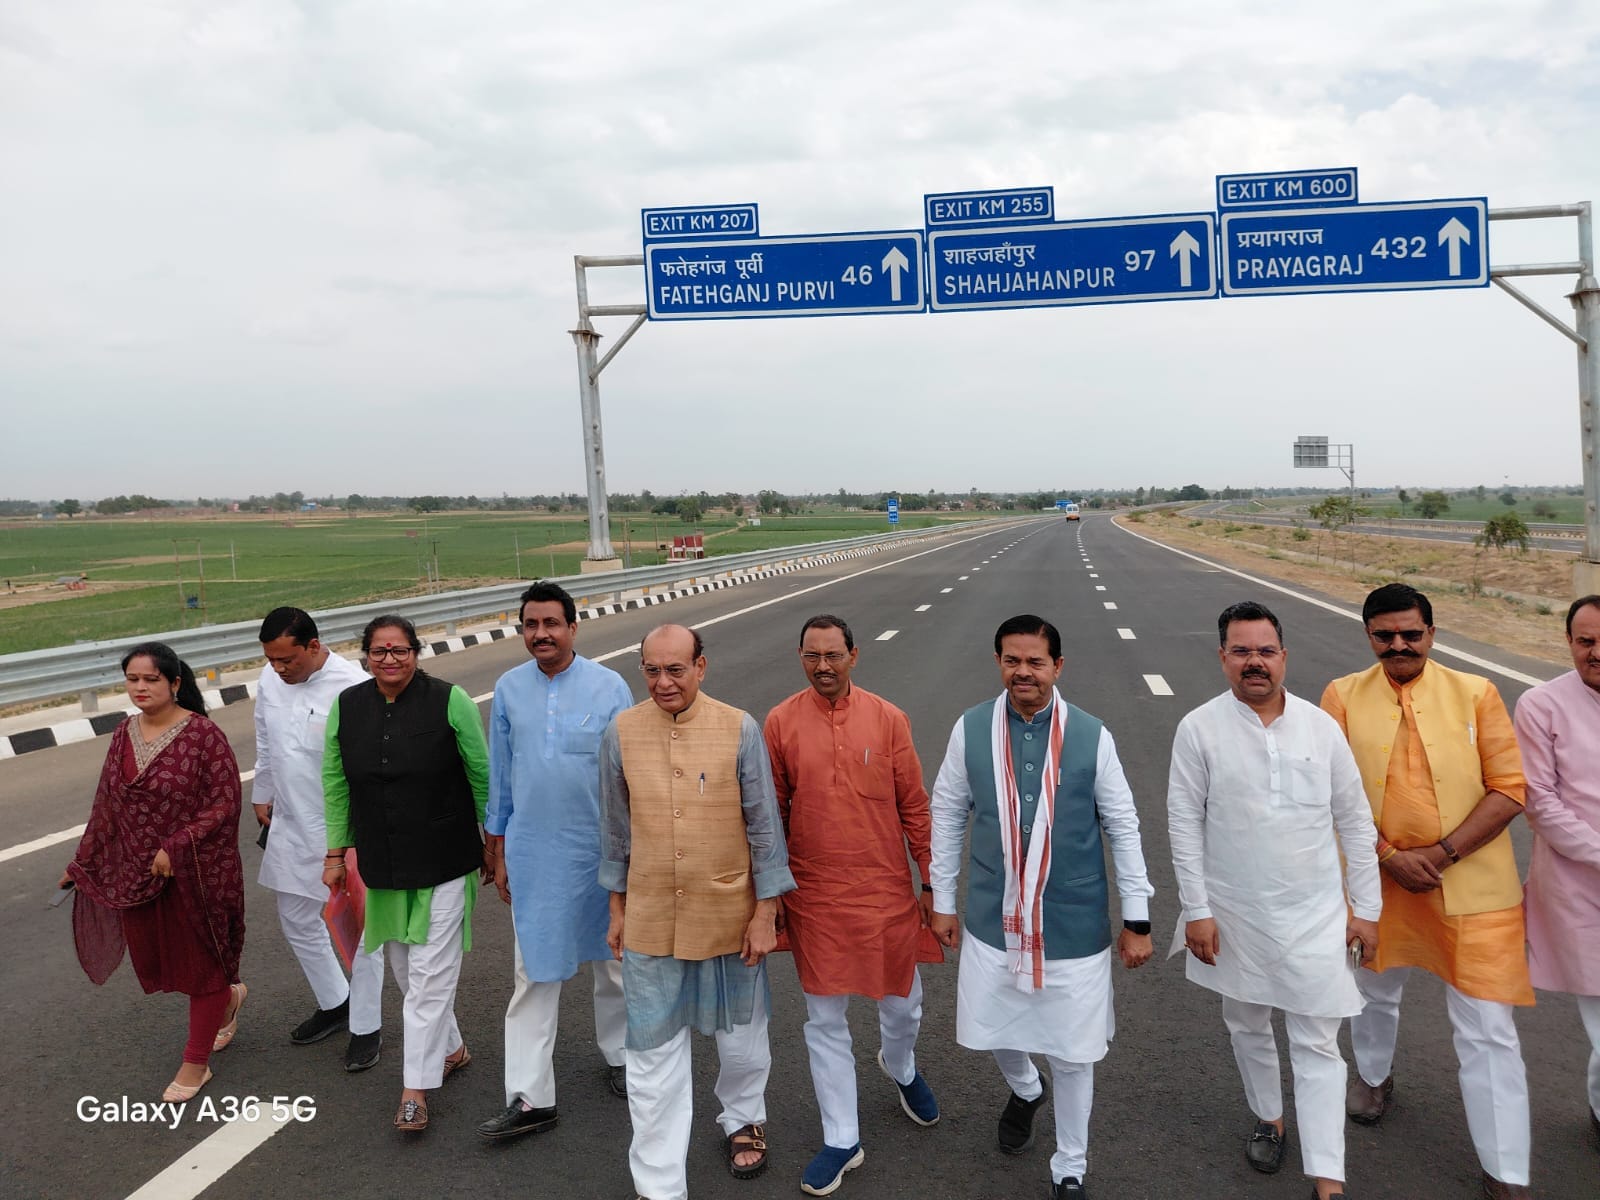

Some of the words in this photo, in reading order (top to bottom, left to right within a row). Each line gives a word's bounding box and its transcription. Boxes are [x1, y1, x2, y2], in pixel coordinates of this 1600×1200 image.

[1227, 182, 1268, 199] EXIT
[1275, 181, 1303, 197] KM
[1310, 178, 1347, 195] 600
[935, 201, 972, 218] EXIT
[979, 199, 1005, 216] KM
[1011, 197, 1044, 213] 255
[650, 216, 685, 231] EXIT
[690, 214, 715, 230] KM
[720, 213, 749, 228] 207
[1236, 228, 1324, 248] प्रयागराज
[1370, 236, 1427, 259] 432
[660, 254, 727, 278] फतेहगंज
[734, 252, 764, 279] पूर्वी
[943, 241, 1036, 268] शाहजहाँपुर
[1124, 249, 1156, 272] 97
[841, 265, 873, 286] 46
[1237, 254, 1363, 279] PRAYAGRAJ
[660, 283, 770, 305] FATEHGANJ
[777, 280, 835, 302] PURVI
[944, 267, 1116, 296] SHAHJAHANPUR
